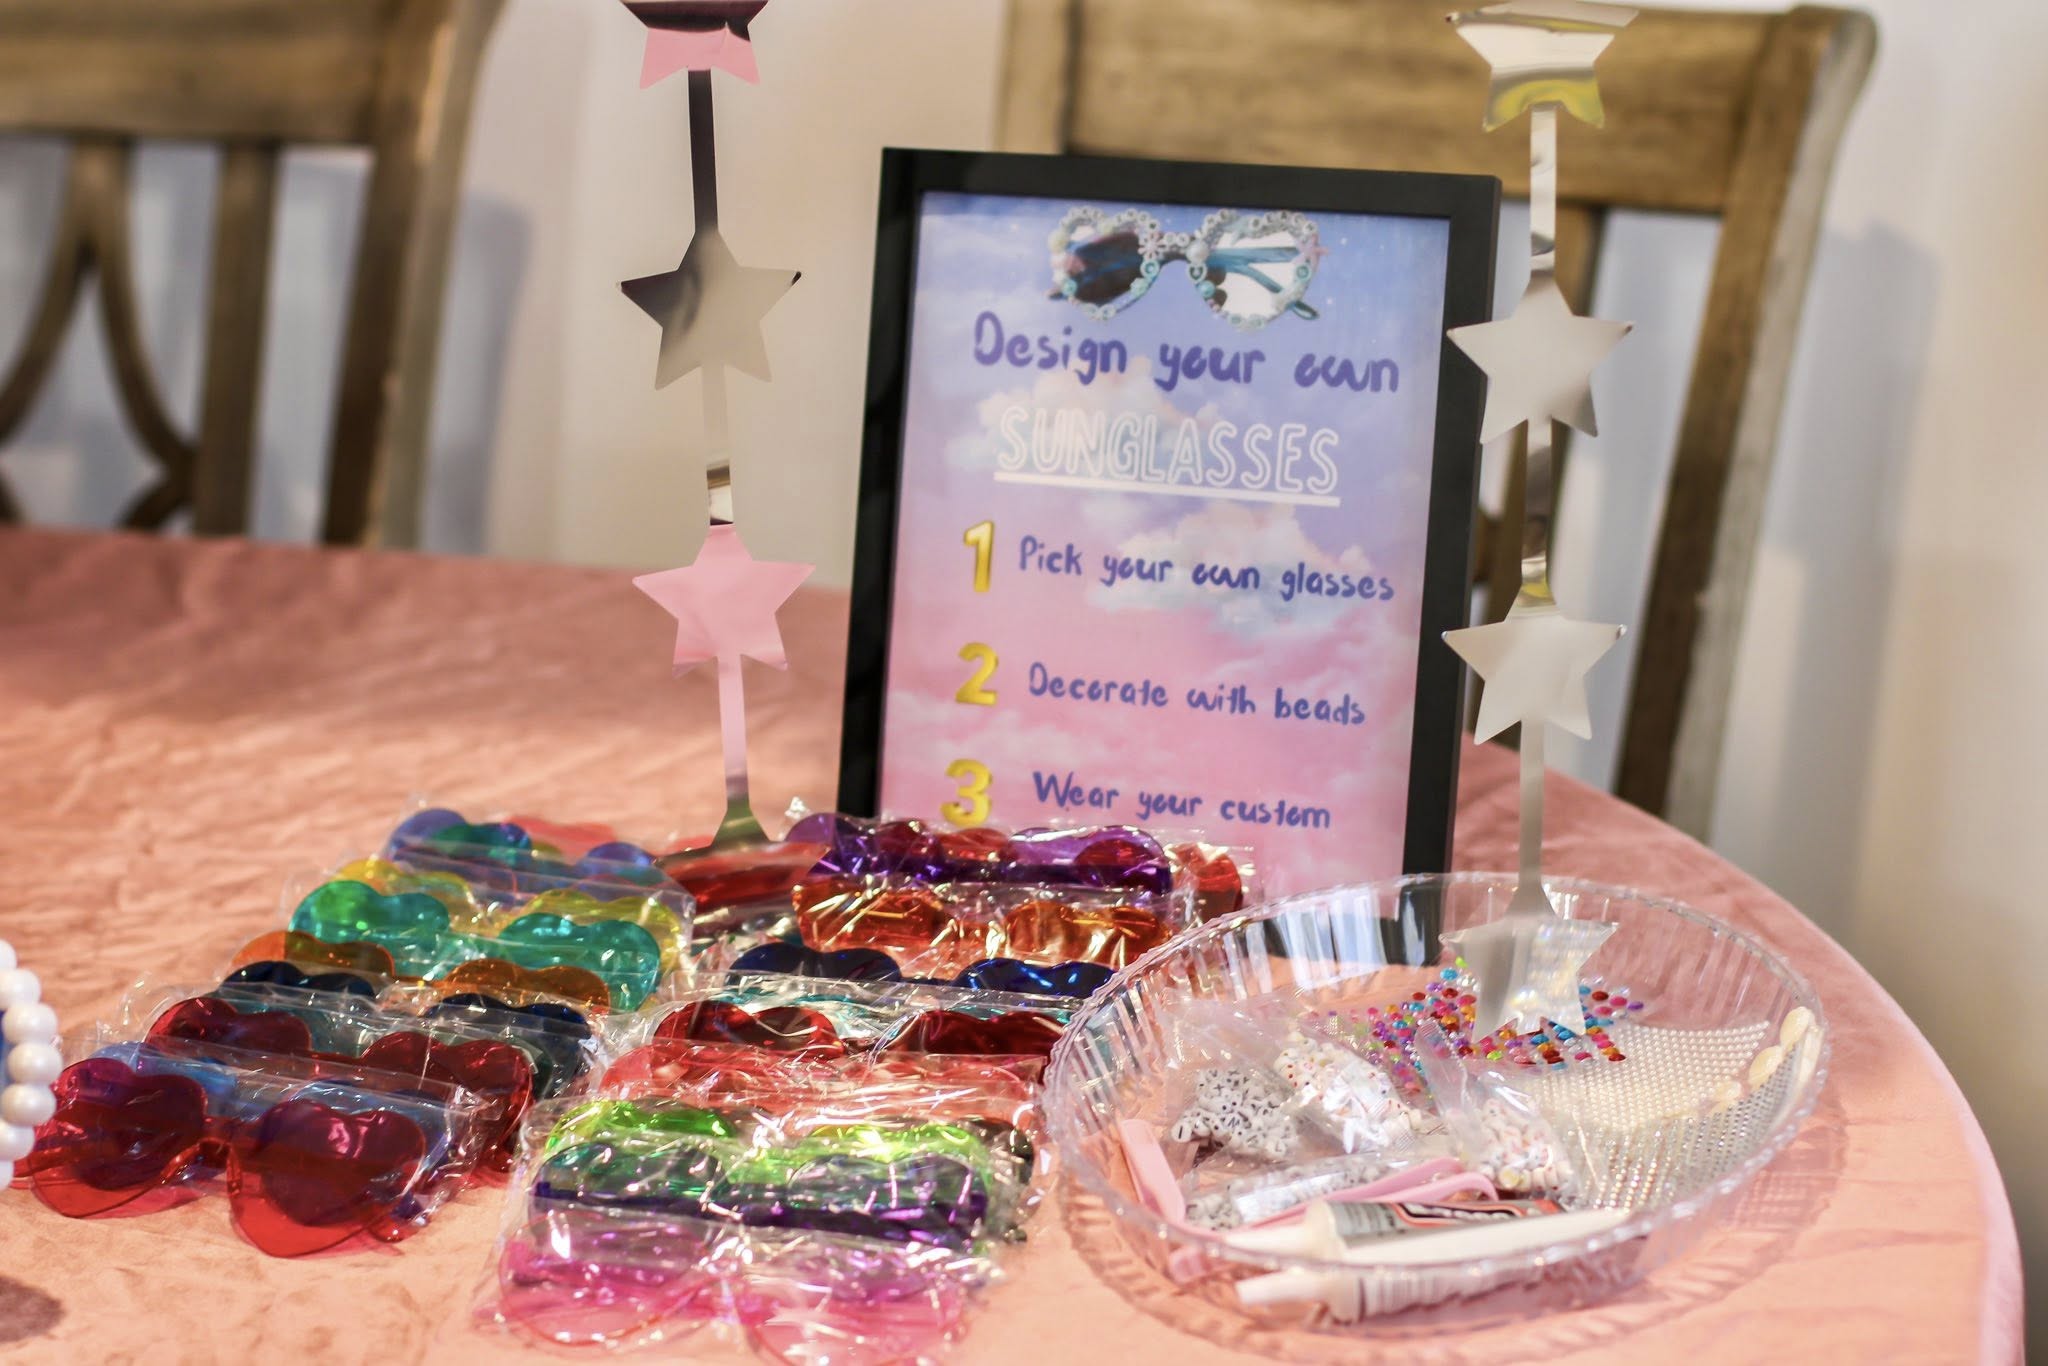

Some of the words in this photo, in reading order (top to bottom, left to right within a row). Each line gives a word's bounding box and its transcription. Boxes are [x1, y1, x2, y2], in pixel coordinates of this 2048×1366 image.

[973, 310, 1128, 386] Design
[1153, 343, 1266, 393] your
[1293, 353, 1399, 393] own
[1000, 406, 1340, 494] SUNGLASSES
[963, 520, 994, 592] 1
[1019, 535, 1082, 576] Pick
[1099, 554, 1174, 588] your
[1191, 562, 1261, 591] own
[1279, 561, 1395, 602] glasses
[956, 643, 999, 706] 2
[1029, 661, 1169, 708] Decorate
[1186, 684, 1257, 715] with
[1274, 687, 1366, 726] beads
[941, 758, 993, 827] 3
[1032, 771, 1120, 809] Wear
[1135, 791, 1203, 821] your
[1219, 799, 1331, 829] custom
